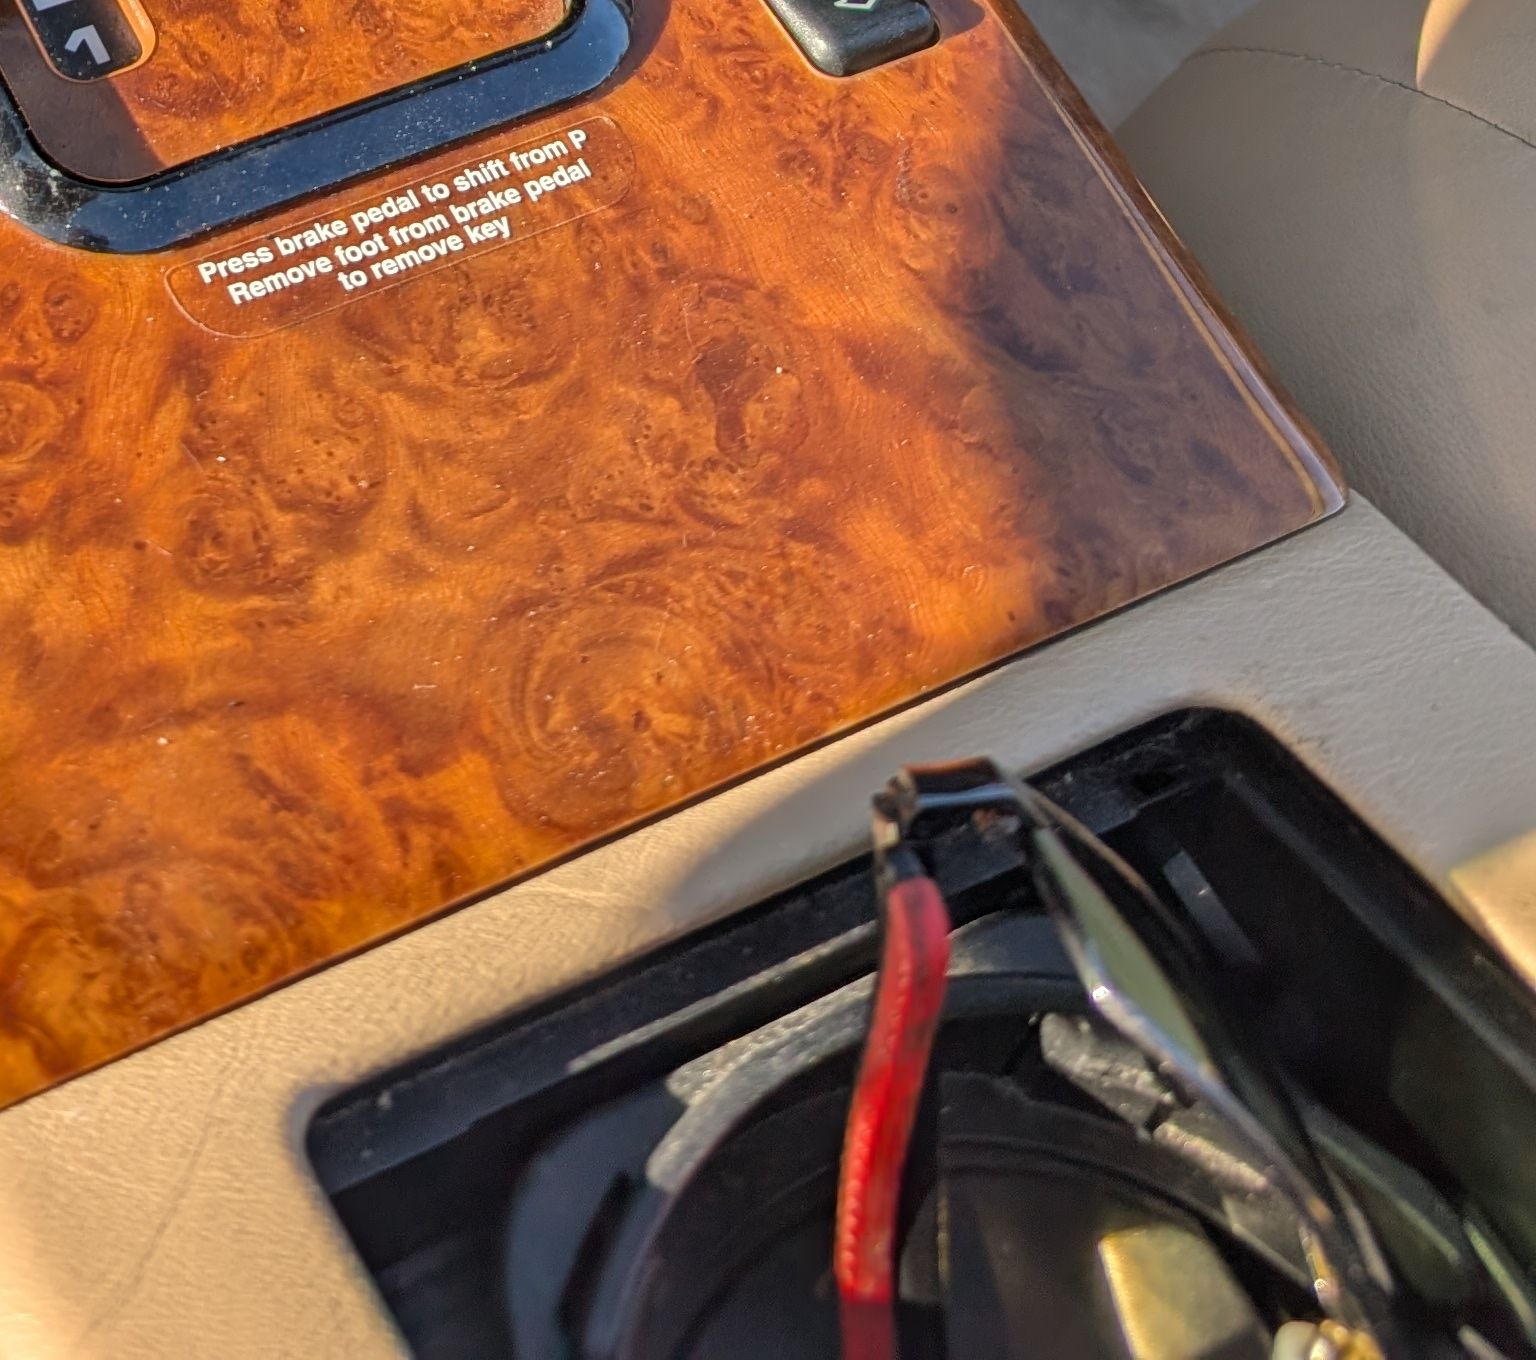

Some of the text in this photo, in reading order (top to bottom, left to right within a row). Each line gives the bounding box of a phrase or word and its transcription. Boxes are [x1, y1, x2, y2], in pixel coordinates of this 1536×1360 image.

[64, 24, 111, 65] 1
[197, 129, 587, 284] Press brake pedal to shift from P
[227, 158, 592, 306] Remove foot from brake pedal
[337, 215, 512, 292] to remove key
